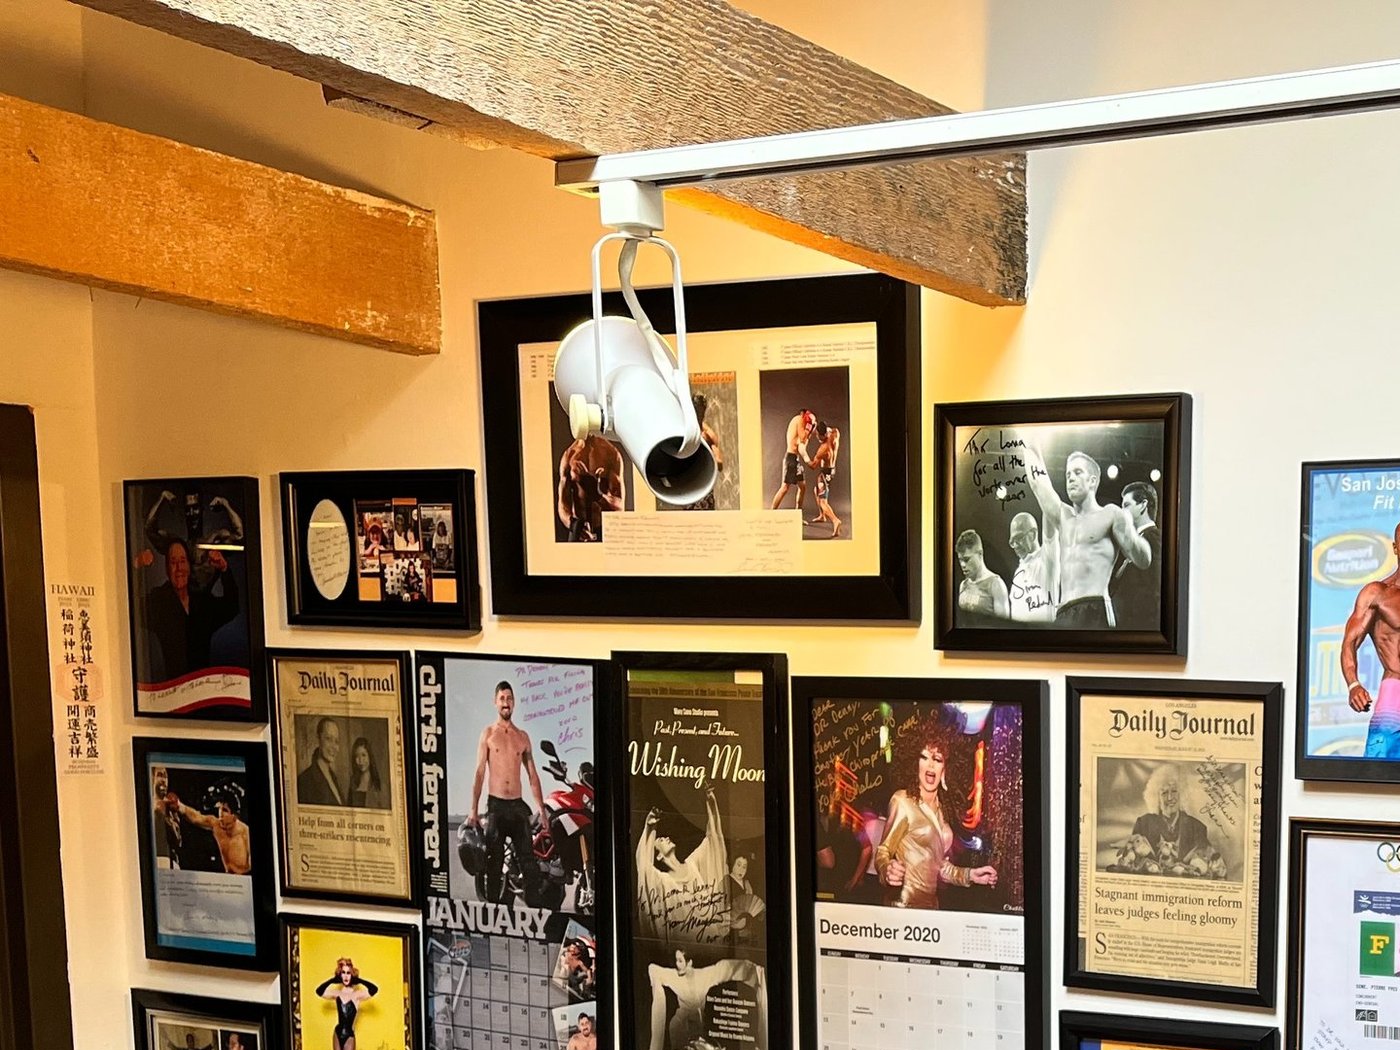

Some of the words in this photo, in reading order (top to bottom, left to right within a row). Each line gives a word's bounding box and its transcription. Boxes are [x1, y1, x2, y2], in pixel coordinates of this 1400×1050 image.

[993, 455, 1005, 472] all
[1005, 474, 1027, 486] over
[1341, 477, 1371, 492] San
[1373, 495, 1395, 510] Fit
[51, 584, 95, 596] HAWAII
[72, 666, 89, 702] 守護
[298, 671, 337, 694] Daily
[338, 672, 394, 696] Journal
[419, 665, 442, 753] chris
[1109, 709, 1166, 739] Daily
[1169, 710, 1255, 740] Journal
[628, 740, 706, 789] Wishing
[708, 744, 765, 783] Moon
[422, 762, 443, 868] ferrer
[1095, 887, 1138, 902] Stagnant
[1142, 890, 1204, 907] immigration
[1207, 896, 1243, 909] reform
[426, 896, 552, 939] JANUARY
[1095, 903, 1124, 916] leaves
[1126, 906, 1159, 921] judges
[1163, 908, 1196, 925] feeling
[1199, 912, 1237, 928] gloomy
[820, 919, 899, 940] December
[903, 926, 940, 943] 2020
[1370, 935, 1389, 954] F
